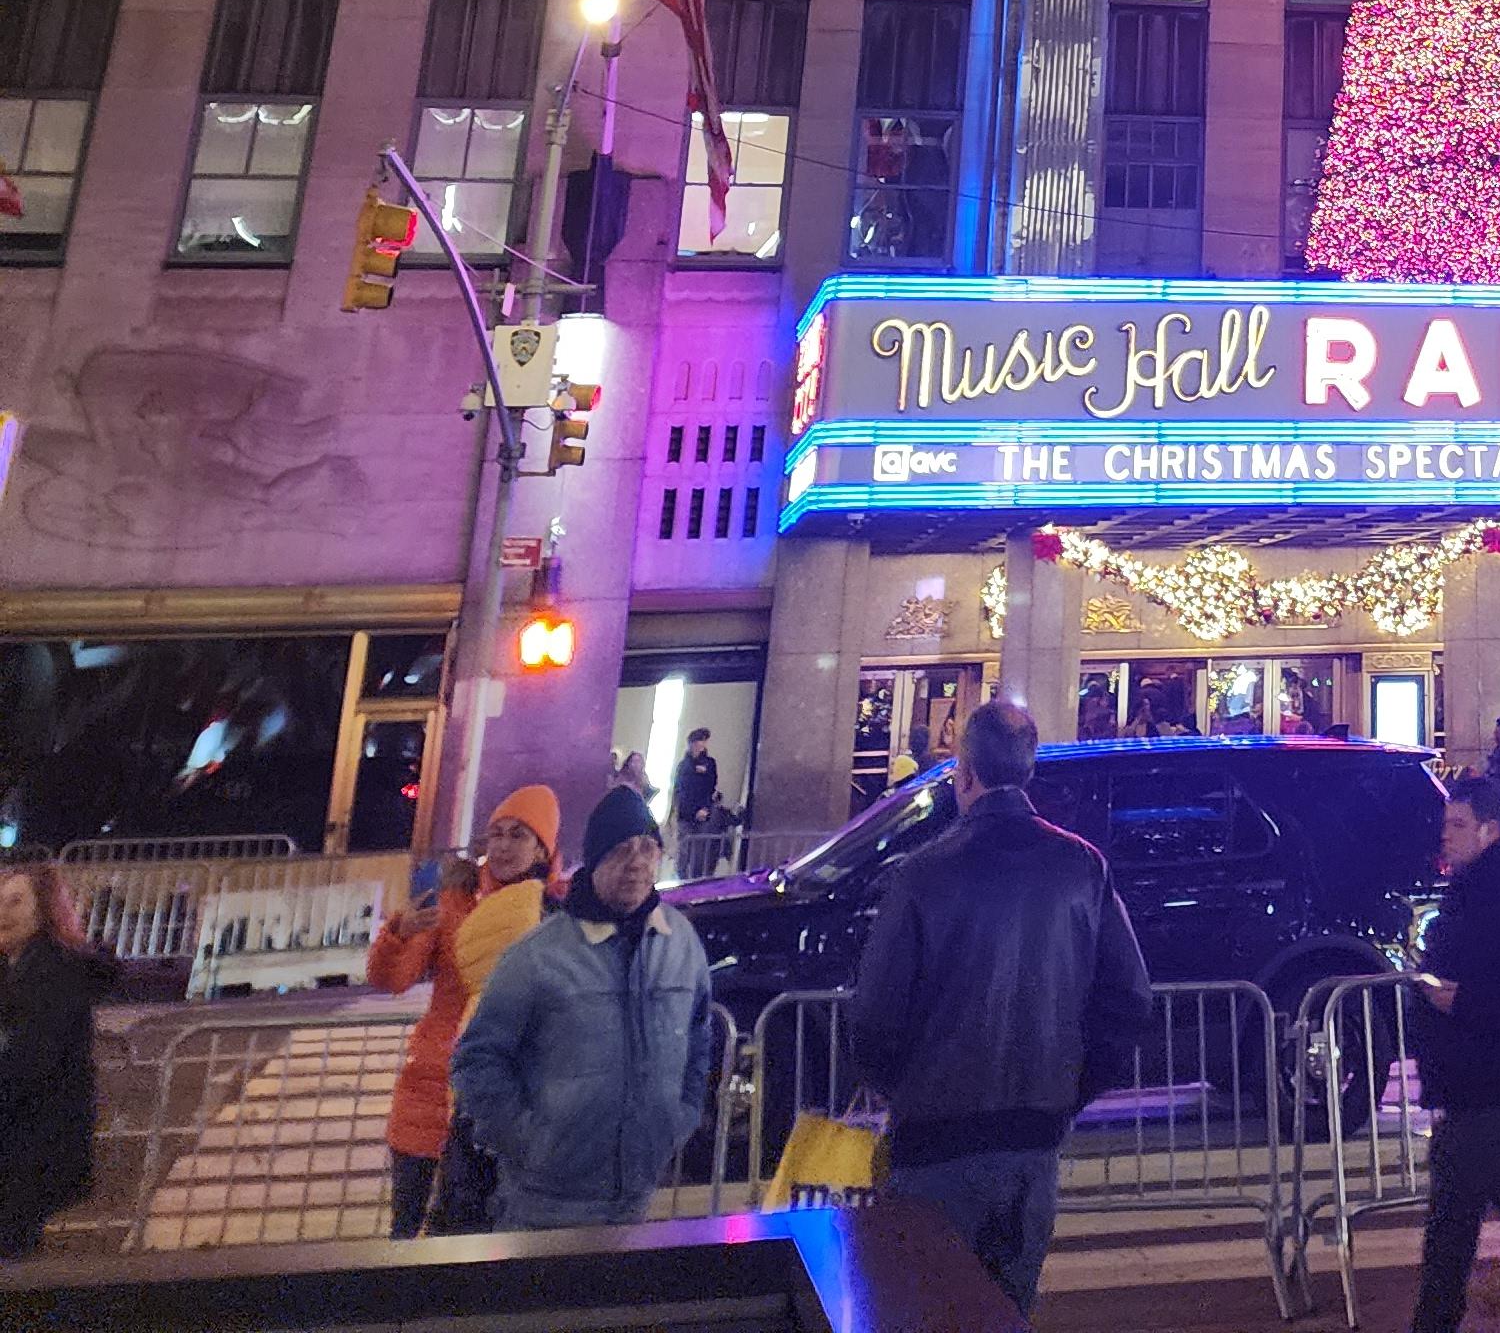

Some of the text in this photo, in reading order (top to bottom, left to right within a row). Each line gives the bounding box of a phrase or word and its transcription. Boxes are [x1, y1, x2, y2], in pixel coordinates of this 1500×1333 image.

[873, 314, 1098, 412] Music
[1083, 304, 1279, 420] Hall
[997, 444, 1072, 481] THE
[1104, 443, 1337, 481] CHRISTMAS
